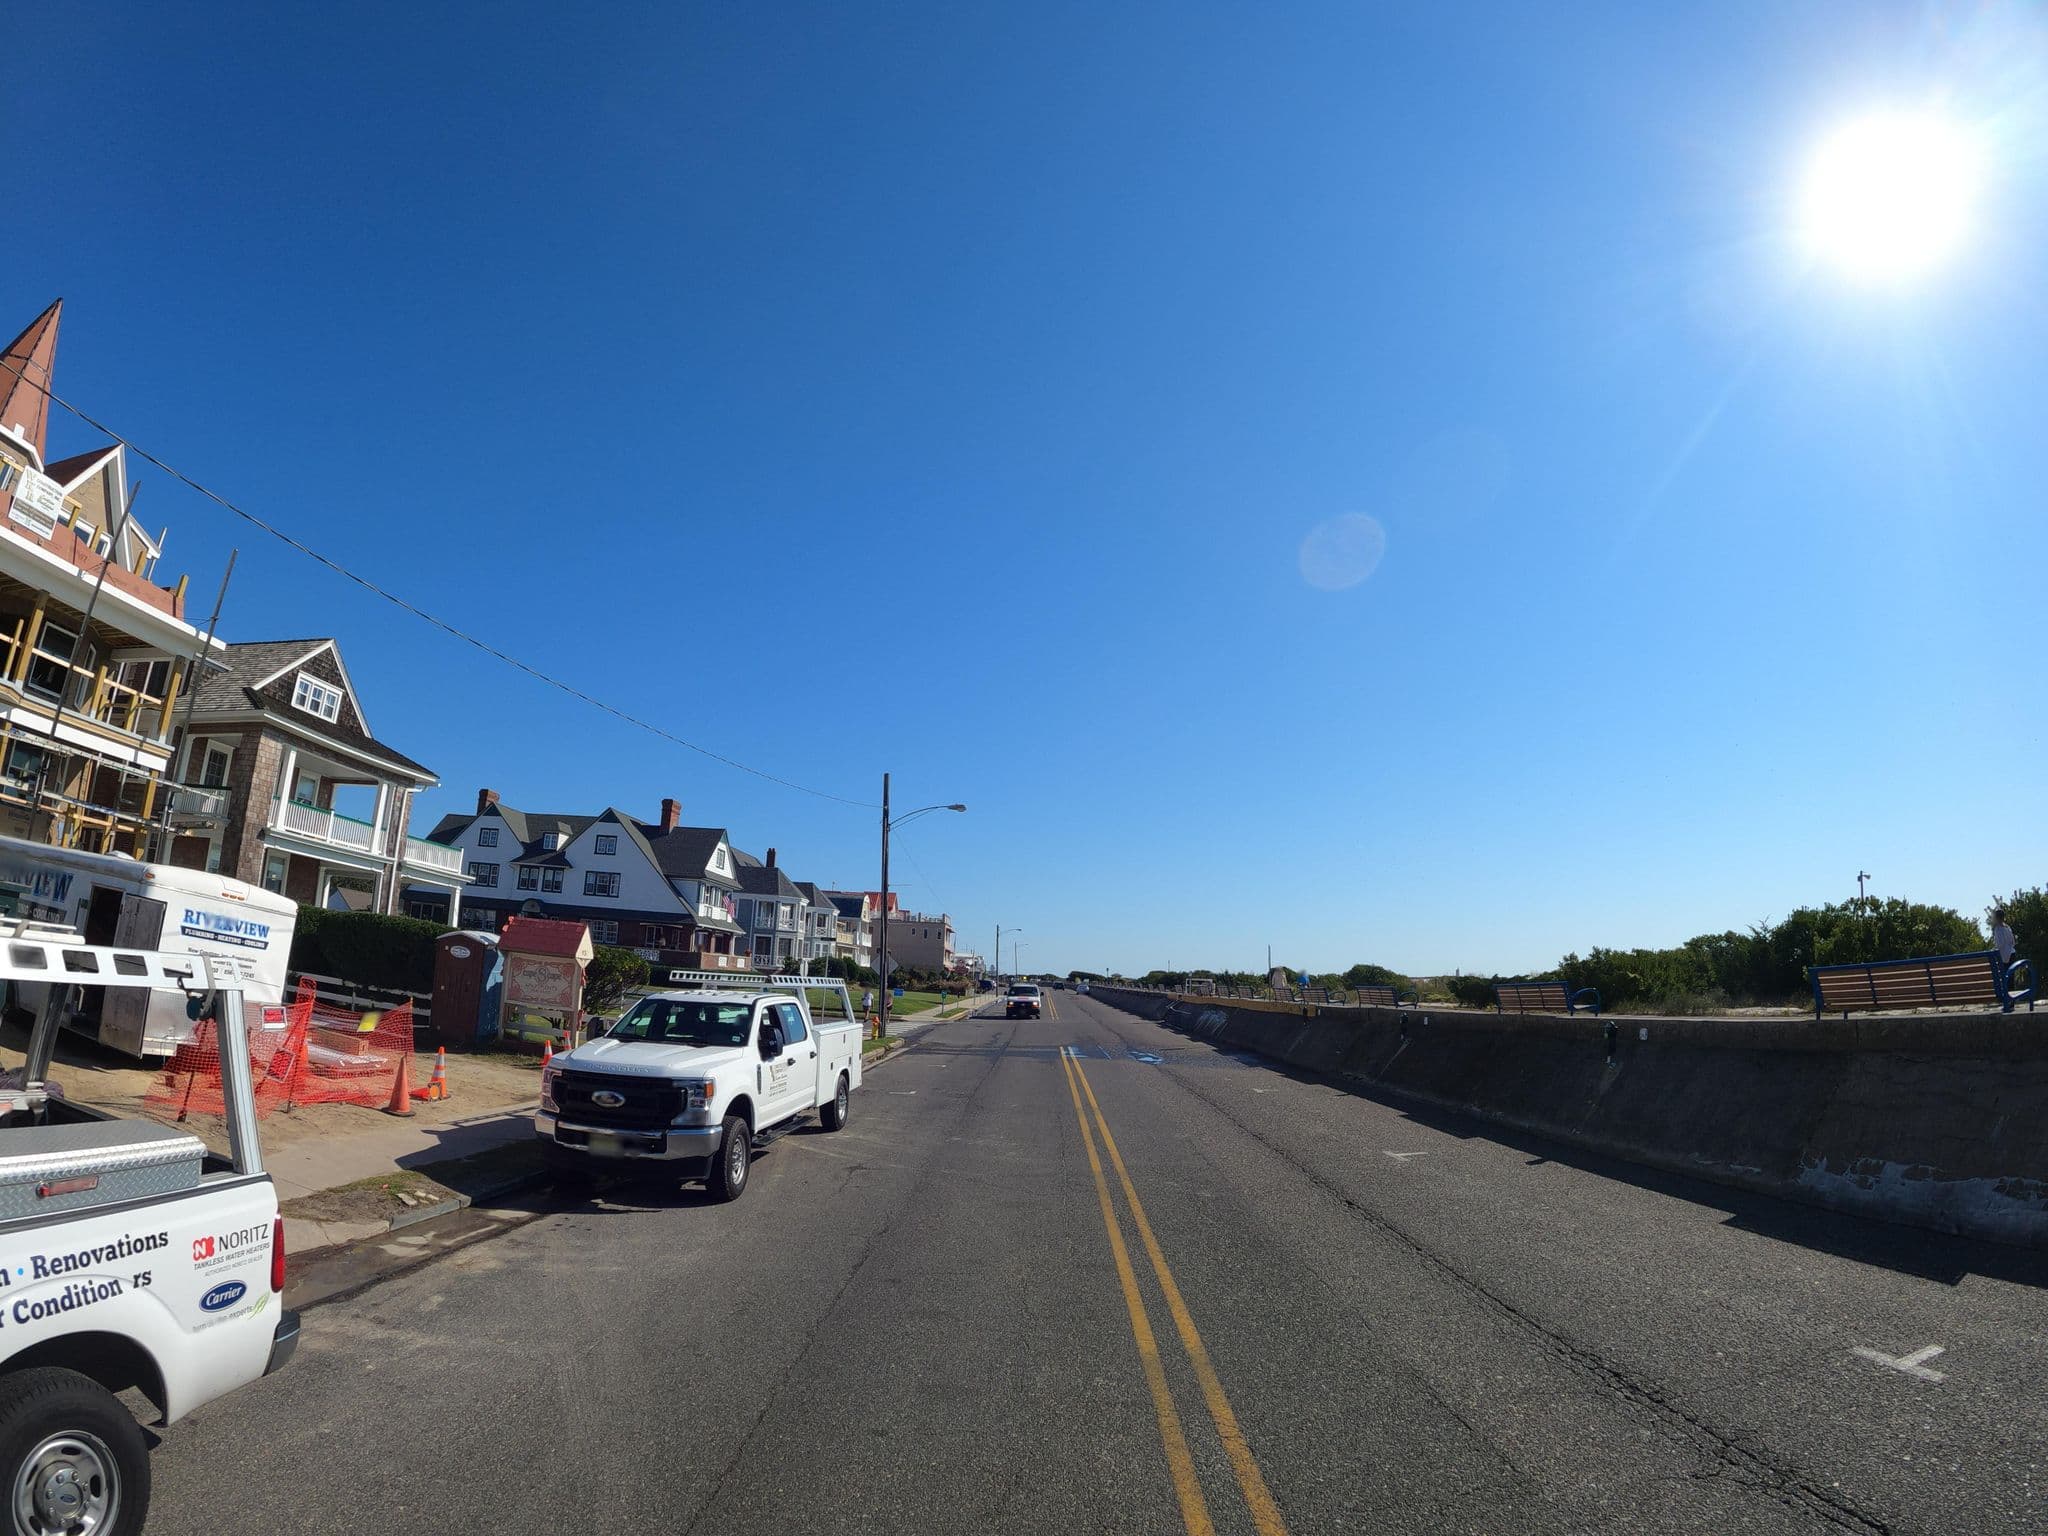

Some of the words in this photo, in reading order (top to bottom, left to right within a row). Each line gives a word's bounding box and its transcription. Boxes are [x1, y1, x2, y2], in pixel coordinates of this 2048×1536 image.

[218, 1223, 269, 1253] NORITZ
[30, 1231, 169, 1280] Renovations
[206, 1286, 242, 1307] Carrier
